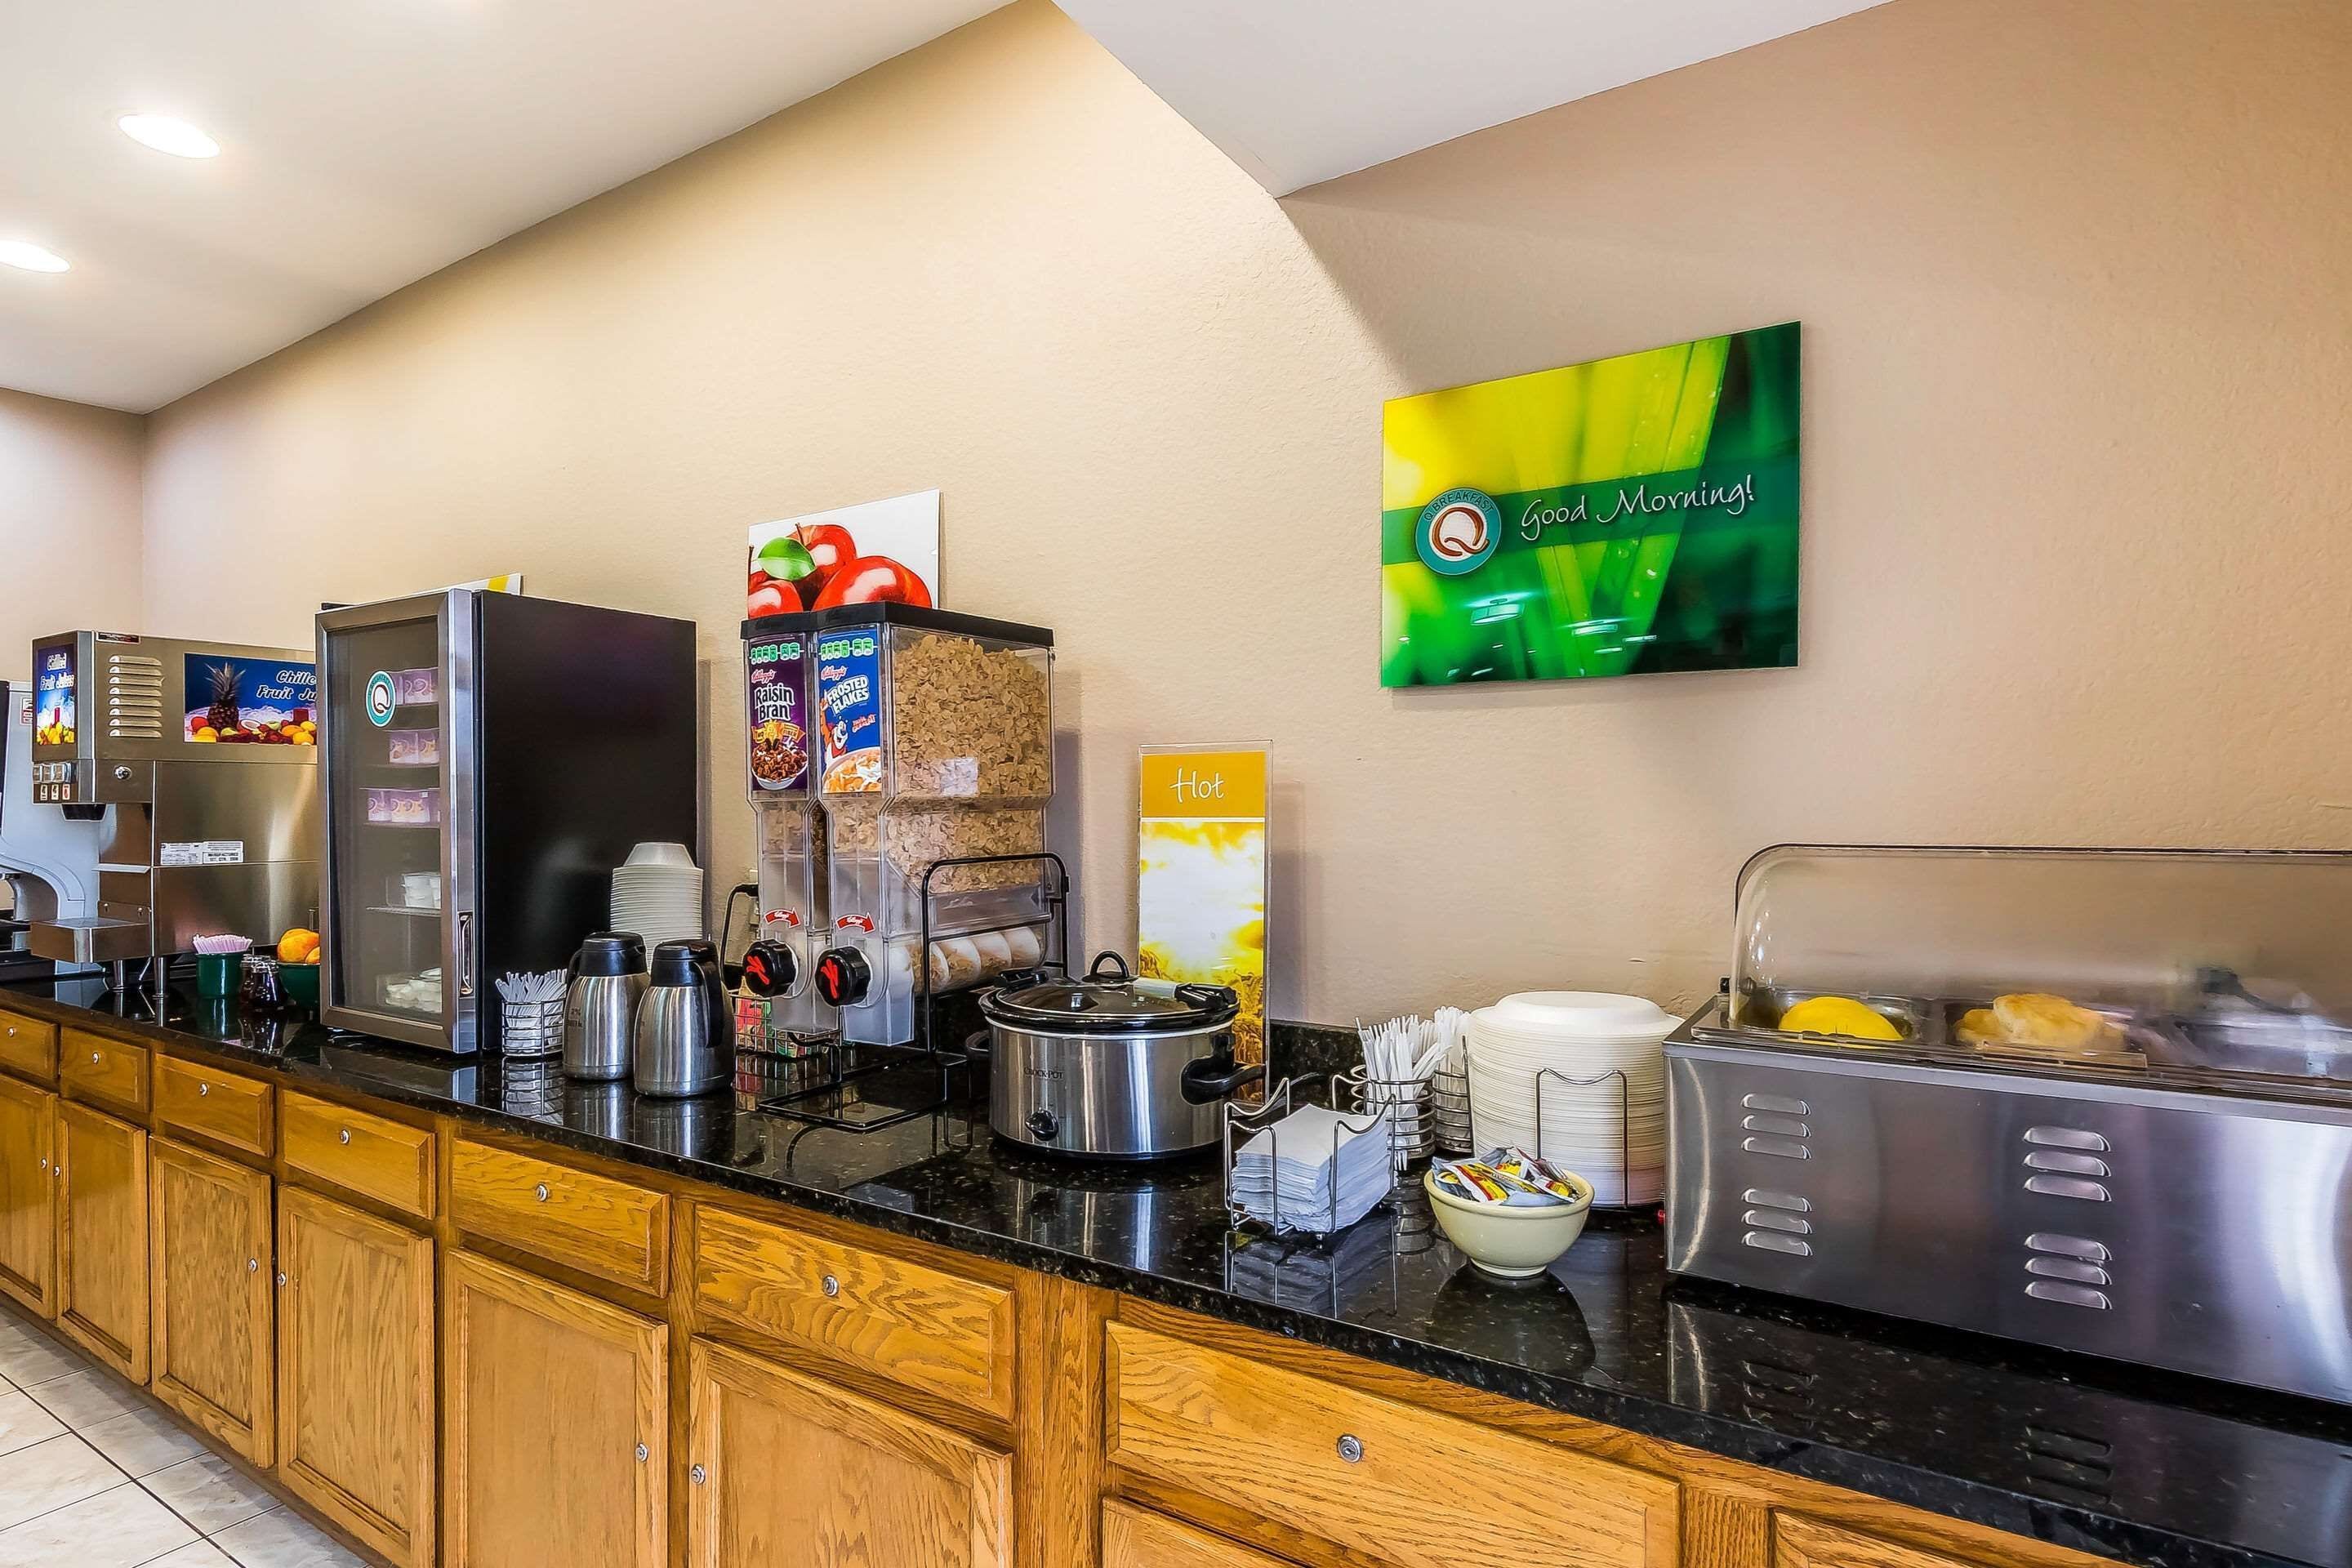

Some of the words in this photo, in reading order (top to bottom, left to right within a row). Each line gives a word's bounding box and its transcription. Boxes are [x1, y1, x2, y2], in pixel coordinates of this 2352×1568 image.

[1432, 491, 1495, 514] BREAKFAST
[1521, 495, 1588, 541] Good
[1596, 474, 1755, 515] Morning!
[1431, 506, 1490, 557] Q
[276, 670, 318, 685] Chille
[826, 675, 870, 706] FROSTED
[256, 684, 295, 700] Fruit
[755, 683, 795, 708] Raisin
[831, 688, 870, 716] FLAKES
[758, 702, 791, 723] Bran
[1169, 767, 1225, 804] Hot
